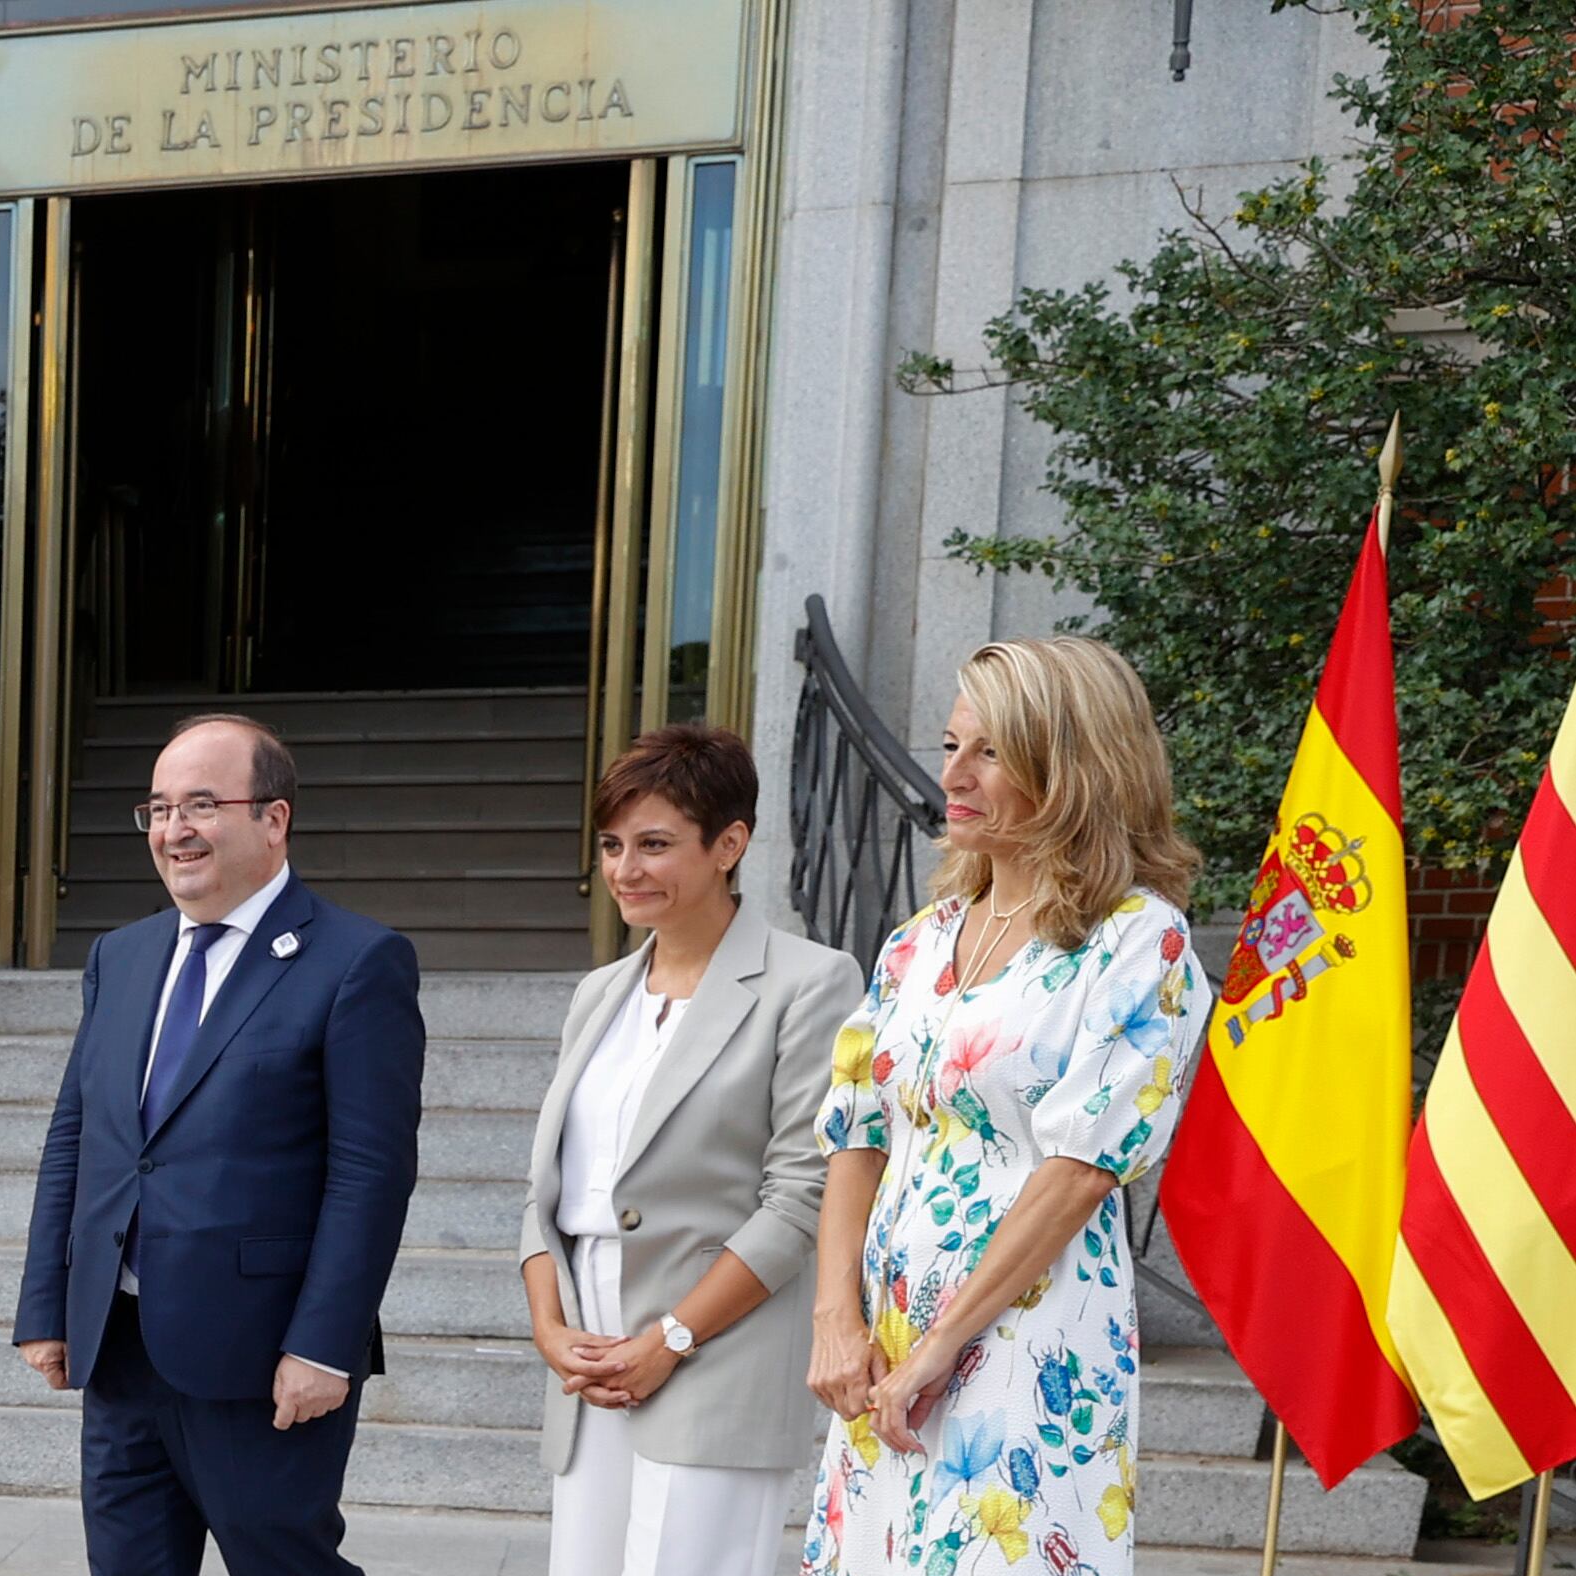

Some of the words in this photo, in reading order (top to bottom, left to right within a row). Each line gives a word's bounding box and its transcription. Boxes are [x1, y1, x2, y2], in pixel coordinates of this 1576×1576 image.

[179, 29, 522, 95] MINISTERIO
[70, 114, 133, 158] DE
[159, 108, 222, 152] LA
[247, 77, 634, 146] PRESIDENCIA
